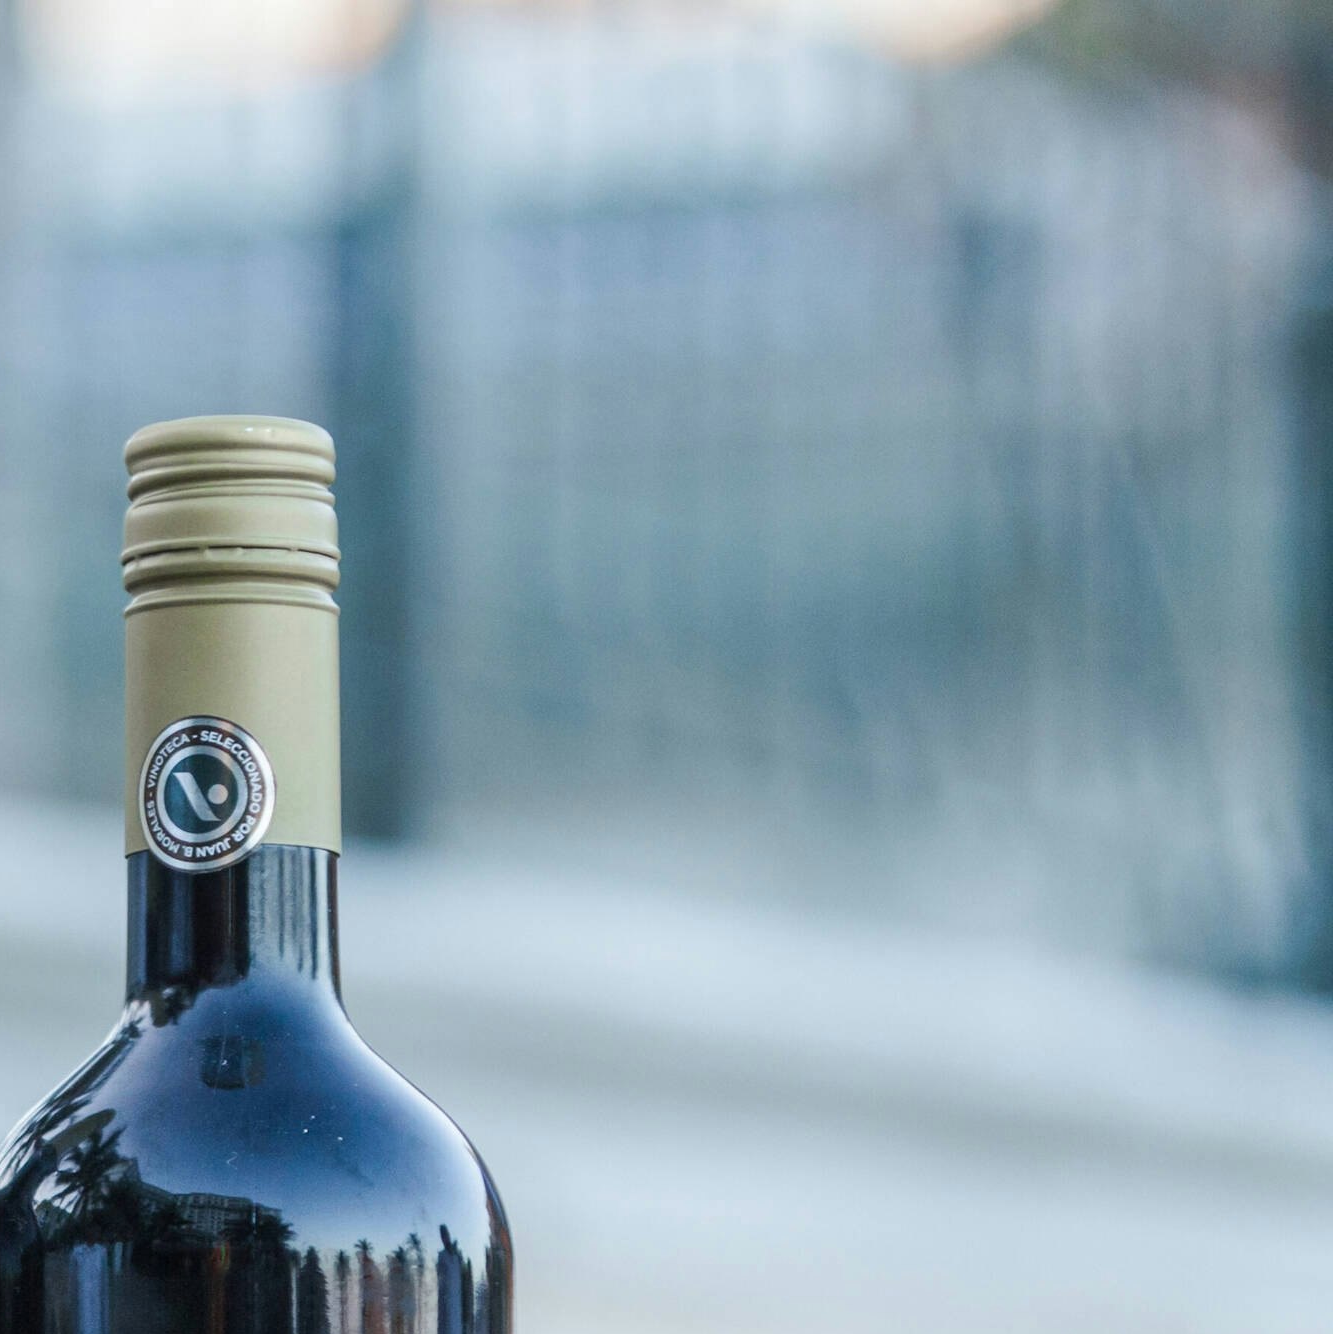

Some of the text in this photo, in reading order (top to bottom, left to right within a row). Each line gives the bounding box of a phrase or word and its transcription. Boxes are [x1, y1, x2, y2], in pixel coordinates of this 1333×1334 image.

[146, 730, 263, 858] VINOTECA SELECCIONADO POR JUAN B. MORALES
